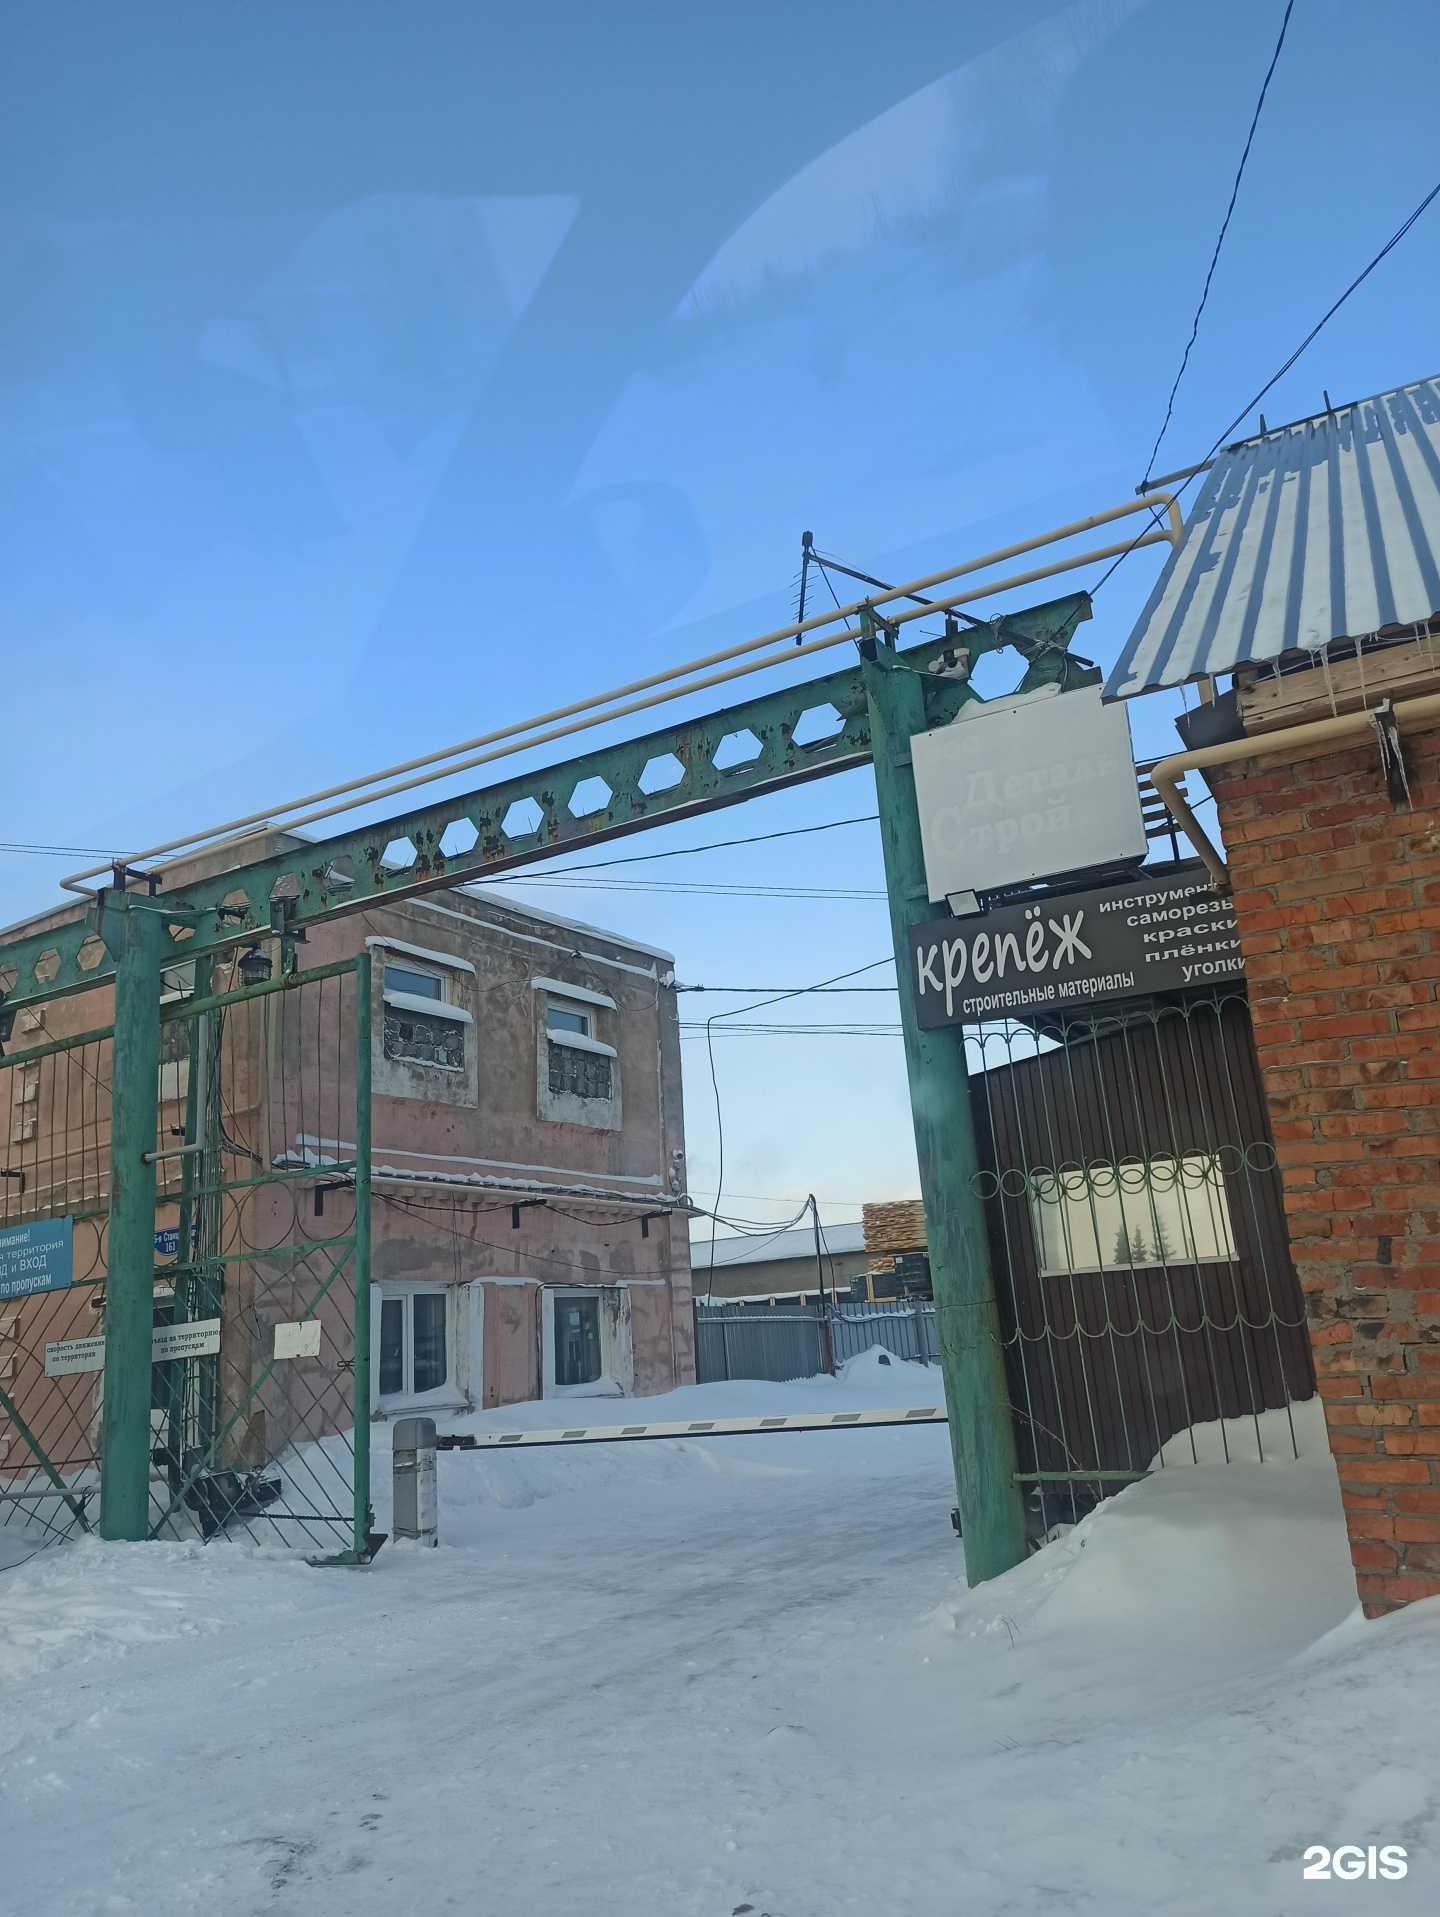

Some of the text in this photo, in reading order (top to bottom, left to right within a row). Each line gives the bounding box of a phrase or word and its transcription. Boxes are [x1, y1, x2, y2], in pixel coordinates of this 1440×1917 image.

[916, 905, 1093, 1017] крепёж
[962, 971, 1135, 1016] строительные материалы
[20, 1254, 47, 1271] ВХОД
[11, 1273, 52, 1294] пропускам
